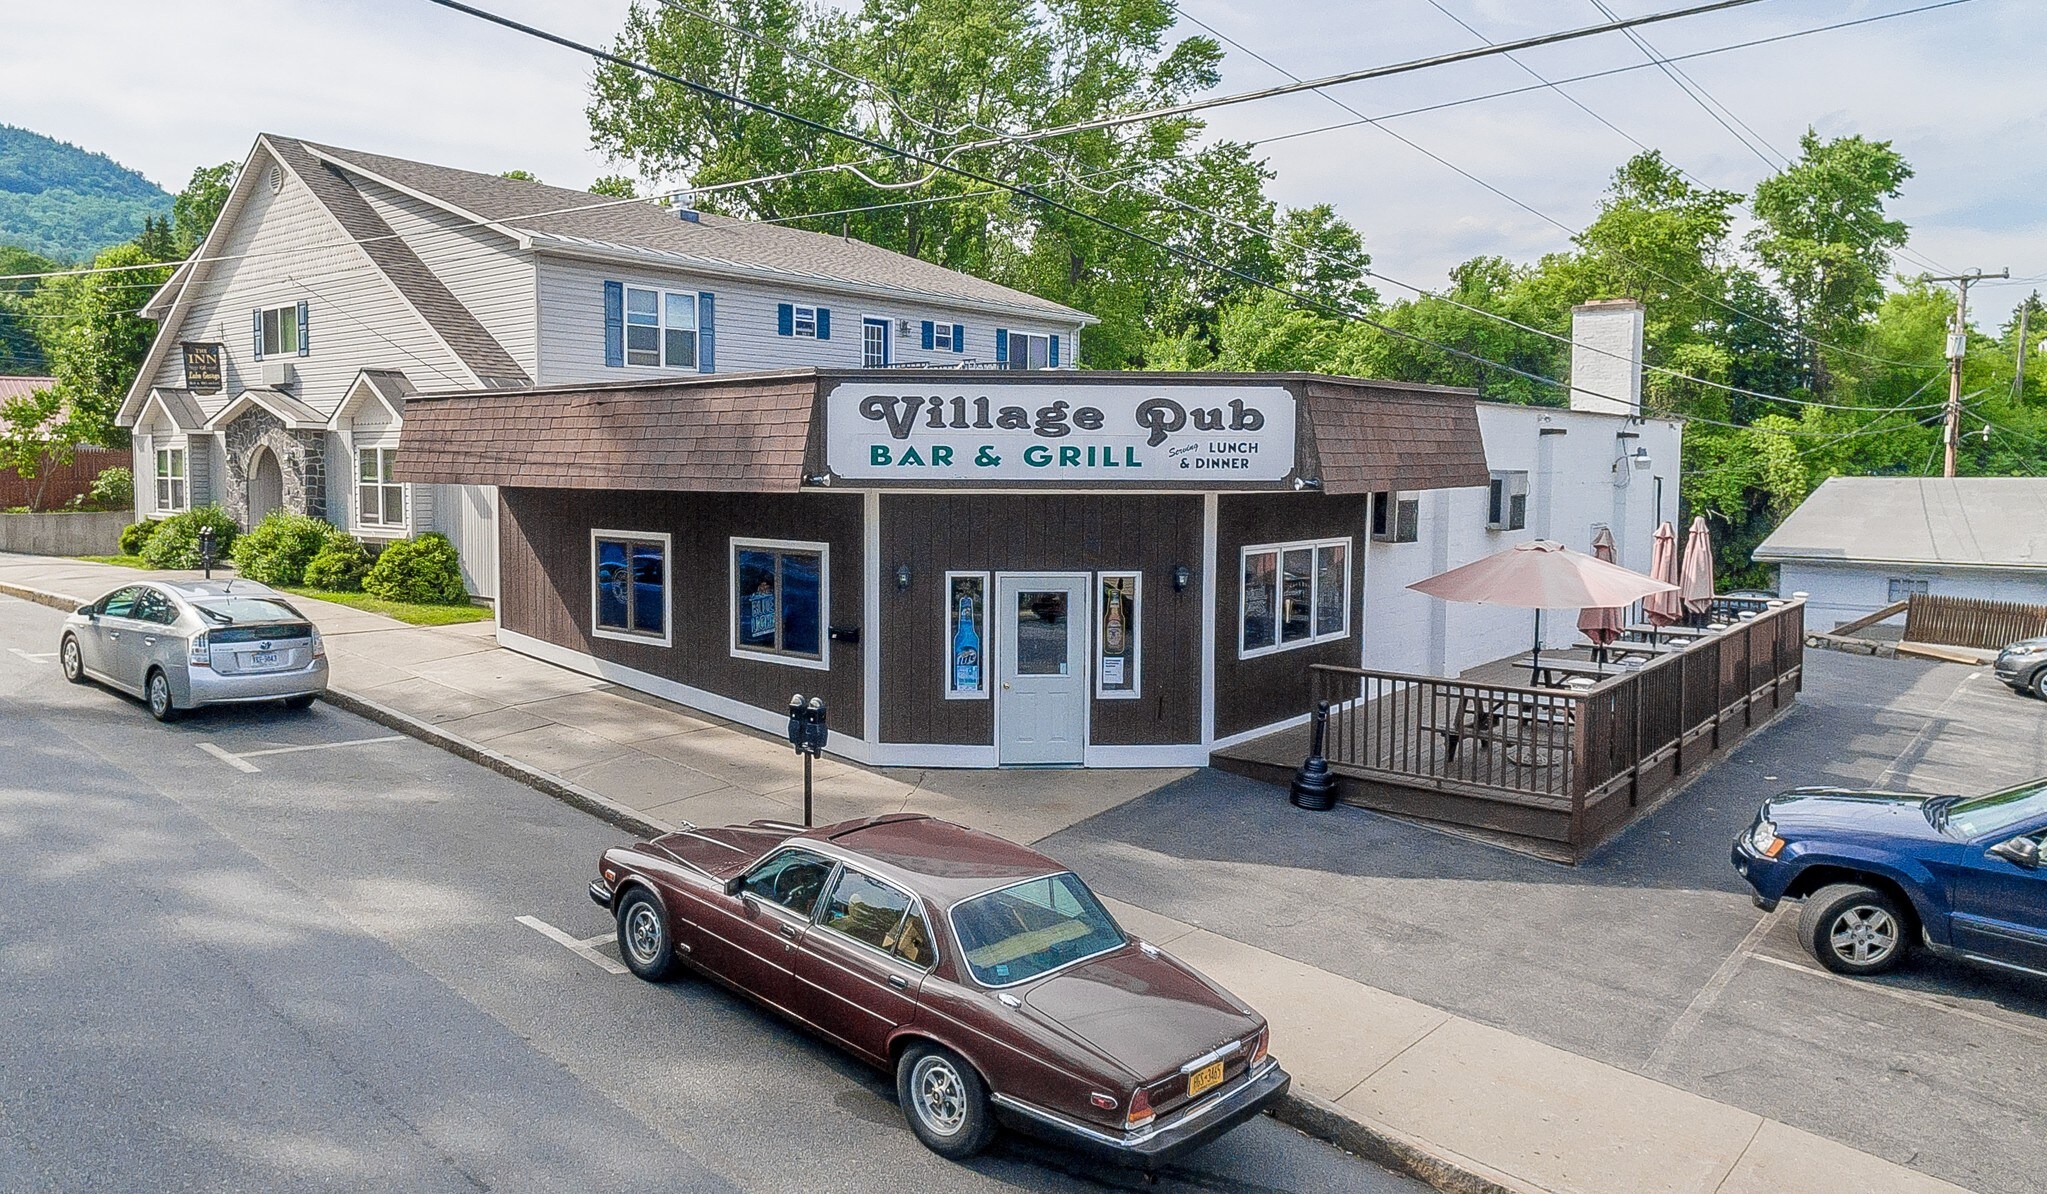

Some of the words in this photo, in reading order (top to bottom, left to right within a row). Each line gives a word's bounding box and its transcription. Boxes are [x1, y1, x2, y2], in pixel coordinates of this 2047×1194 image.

[188, 353, 217, 364] INN
[859, 394, 1105, 439] Village
[1135, 397, 1267, 447] Pub
[869, 444, 954, 467] BAR
[974, 445, 1002, 467] &
[1023, 445, 1143, 468] GRILL
[1168, 443, 1199, 458] Serving
[1209, 442, 1259, 454] LUNCH
[1179, 457, 1190, 469] &
[1195, 457, 1249, 469] DINNER
